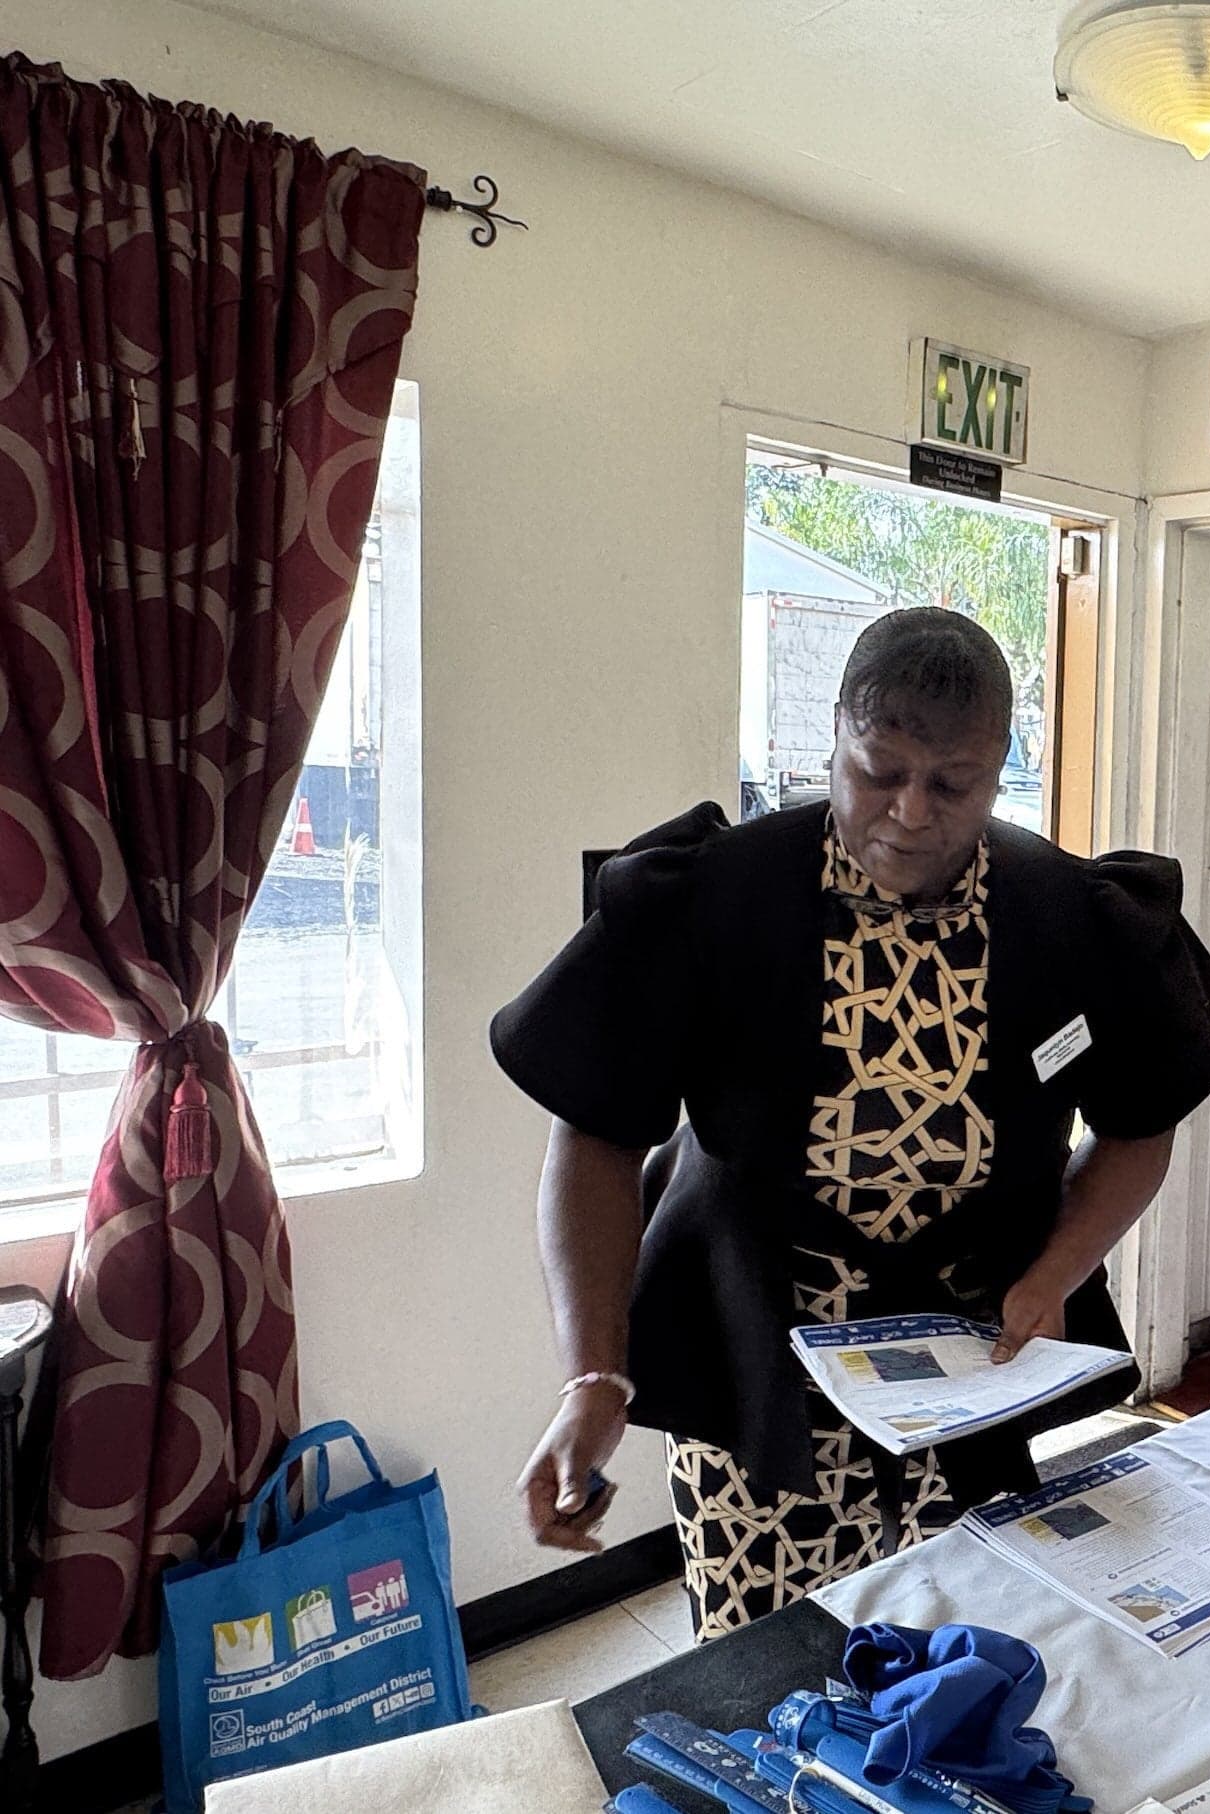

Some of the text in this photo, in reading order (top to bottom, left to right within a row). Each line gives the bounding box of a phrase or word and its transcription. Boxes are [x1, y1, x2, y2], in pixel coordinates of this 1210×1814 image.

[936, 353, 1023, 455] EXIT
[918, 451, 934, 464] This
[936, 455, 957, 468] Door
[968, 463, 996, 478] Remain
[938, 467, 975, 484] Unlocked
[922, 475, 945, 489] During
[946, 480, 971, 494] Business
[211, 1616, 420, 1701] Our Air Our Health Our Future
[246, 1737, 265, 1750] Air
[269, 1720, 309, 1743] Quality
[311, 1682, 388, 1725] Management
[390, 1667, 432, 1692] District
[246, 1700, 317, 1737] South Coast
